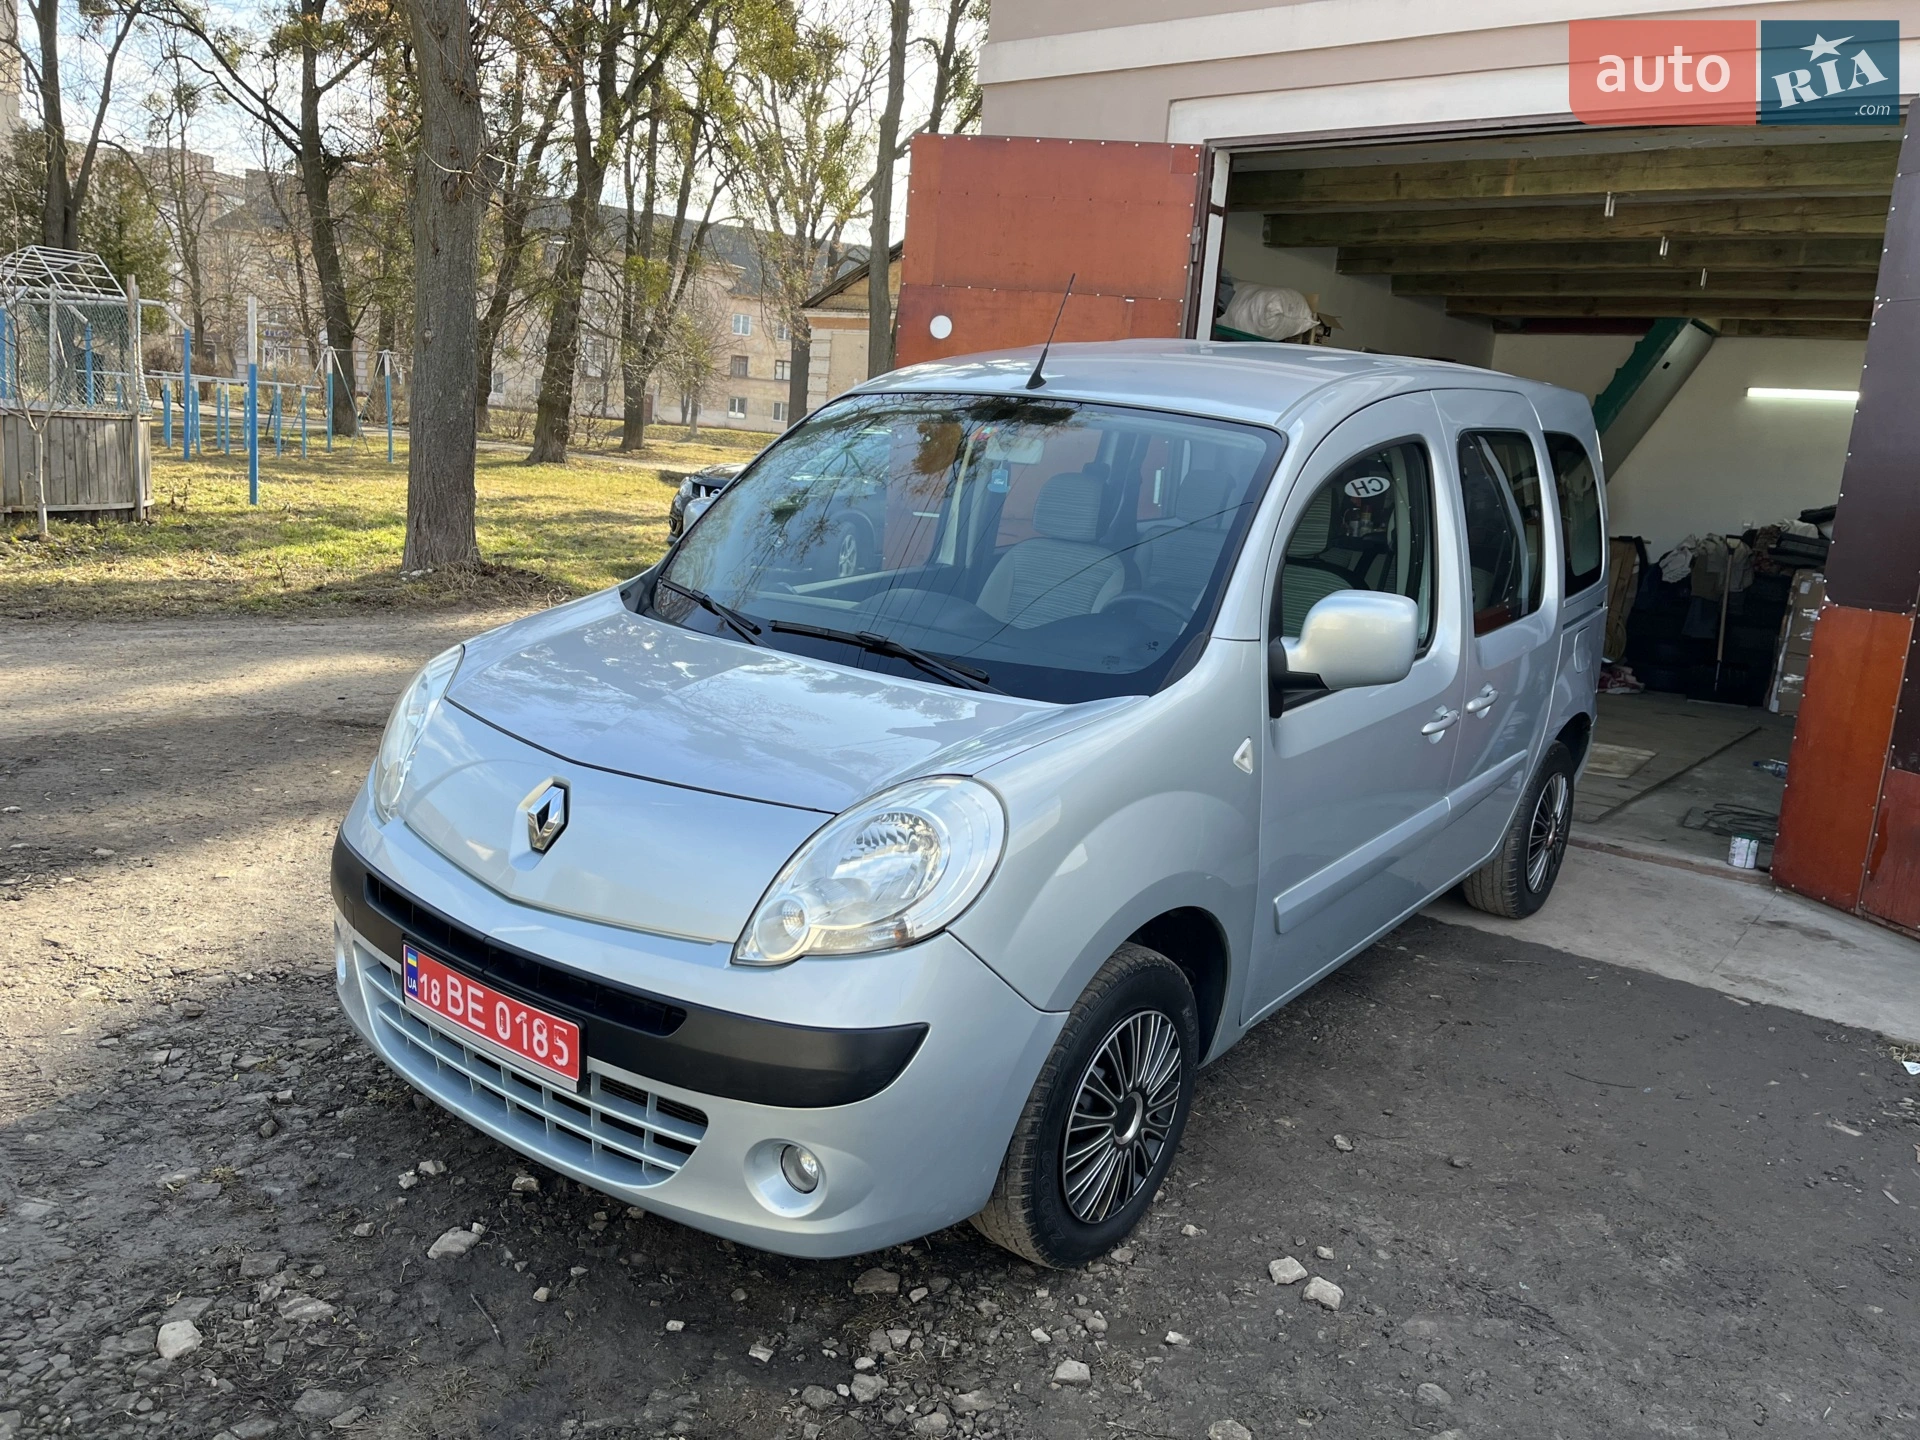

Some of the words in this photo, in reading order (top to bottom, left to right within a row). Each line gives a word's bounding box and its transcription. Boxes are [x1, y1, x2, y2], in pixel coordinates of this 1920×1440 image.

[407, 976, 418, 992] UA
[420, 973, 440, 1006] 18
[447, 974, 486, 1030] BE
[495, 1001, 568, 1066] 0185
